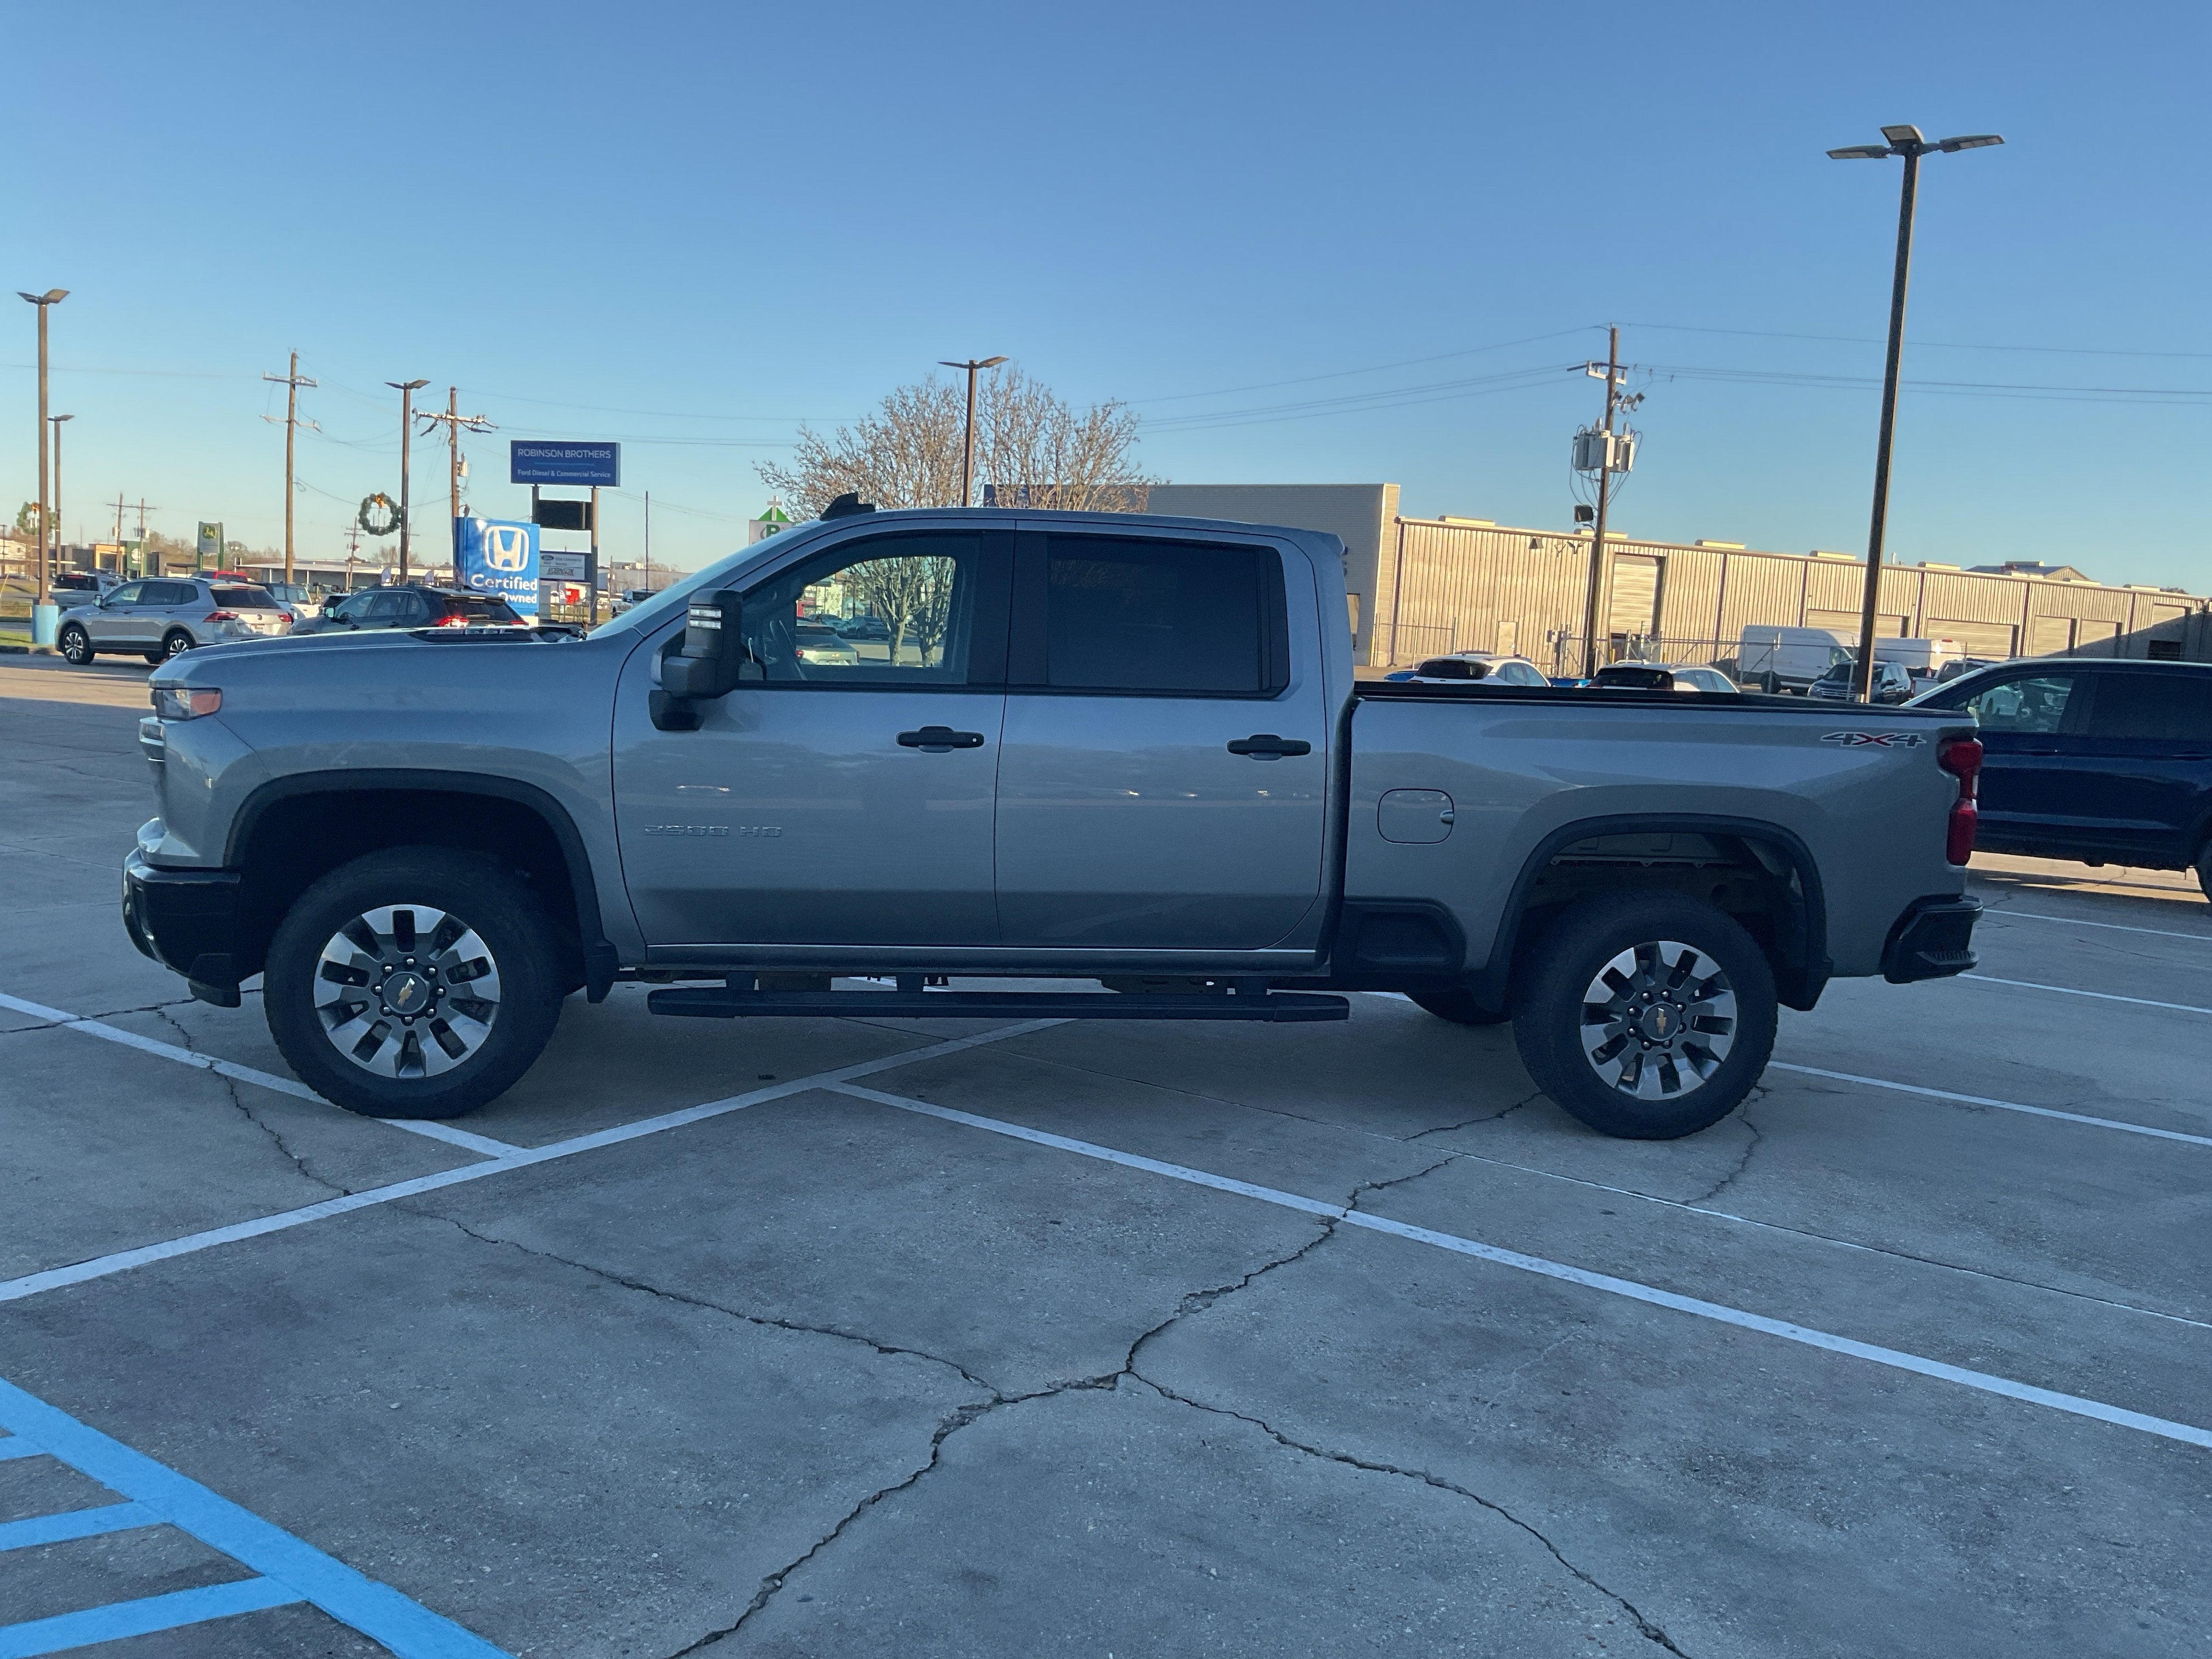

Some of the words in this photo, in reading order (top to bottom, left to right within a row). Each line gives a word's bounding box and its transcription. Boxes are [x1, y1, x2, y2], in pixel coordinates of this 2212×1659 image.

[517, 449, 563, 458] ROBINSON
[565, 450, 611, 459] BROTHERS
[766, 524, 780, 538] P
[471, 574, 538, 591] Certified
[645, 825, 728, 836] 2500
[740, 826, 781, 837] HD
